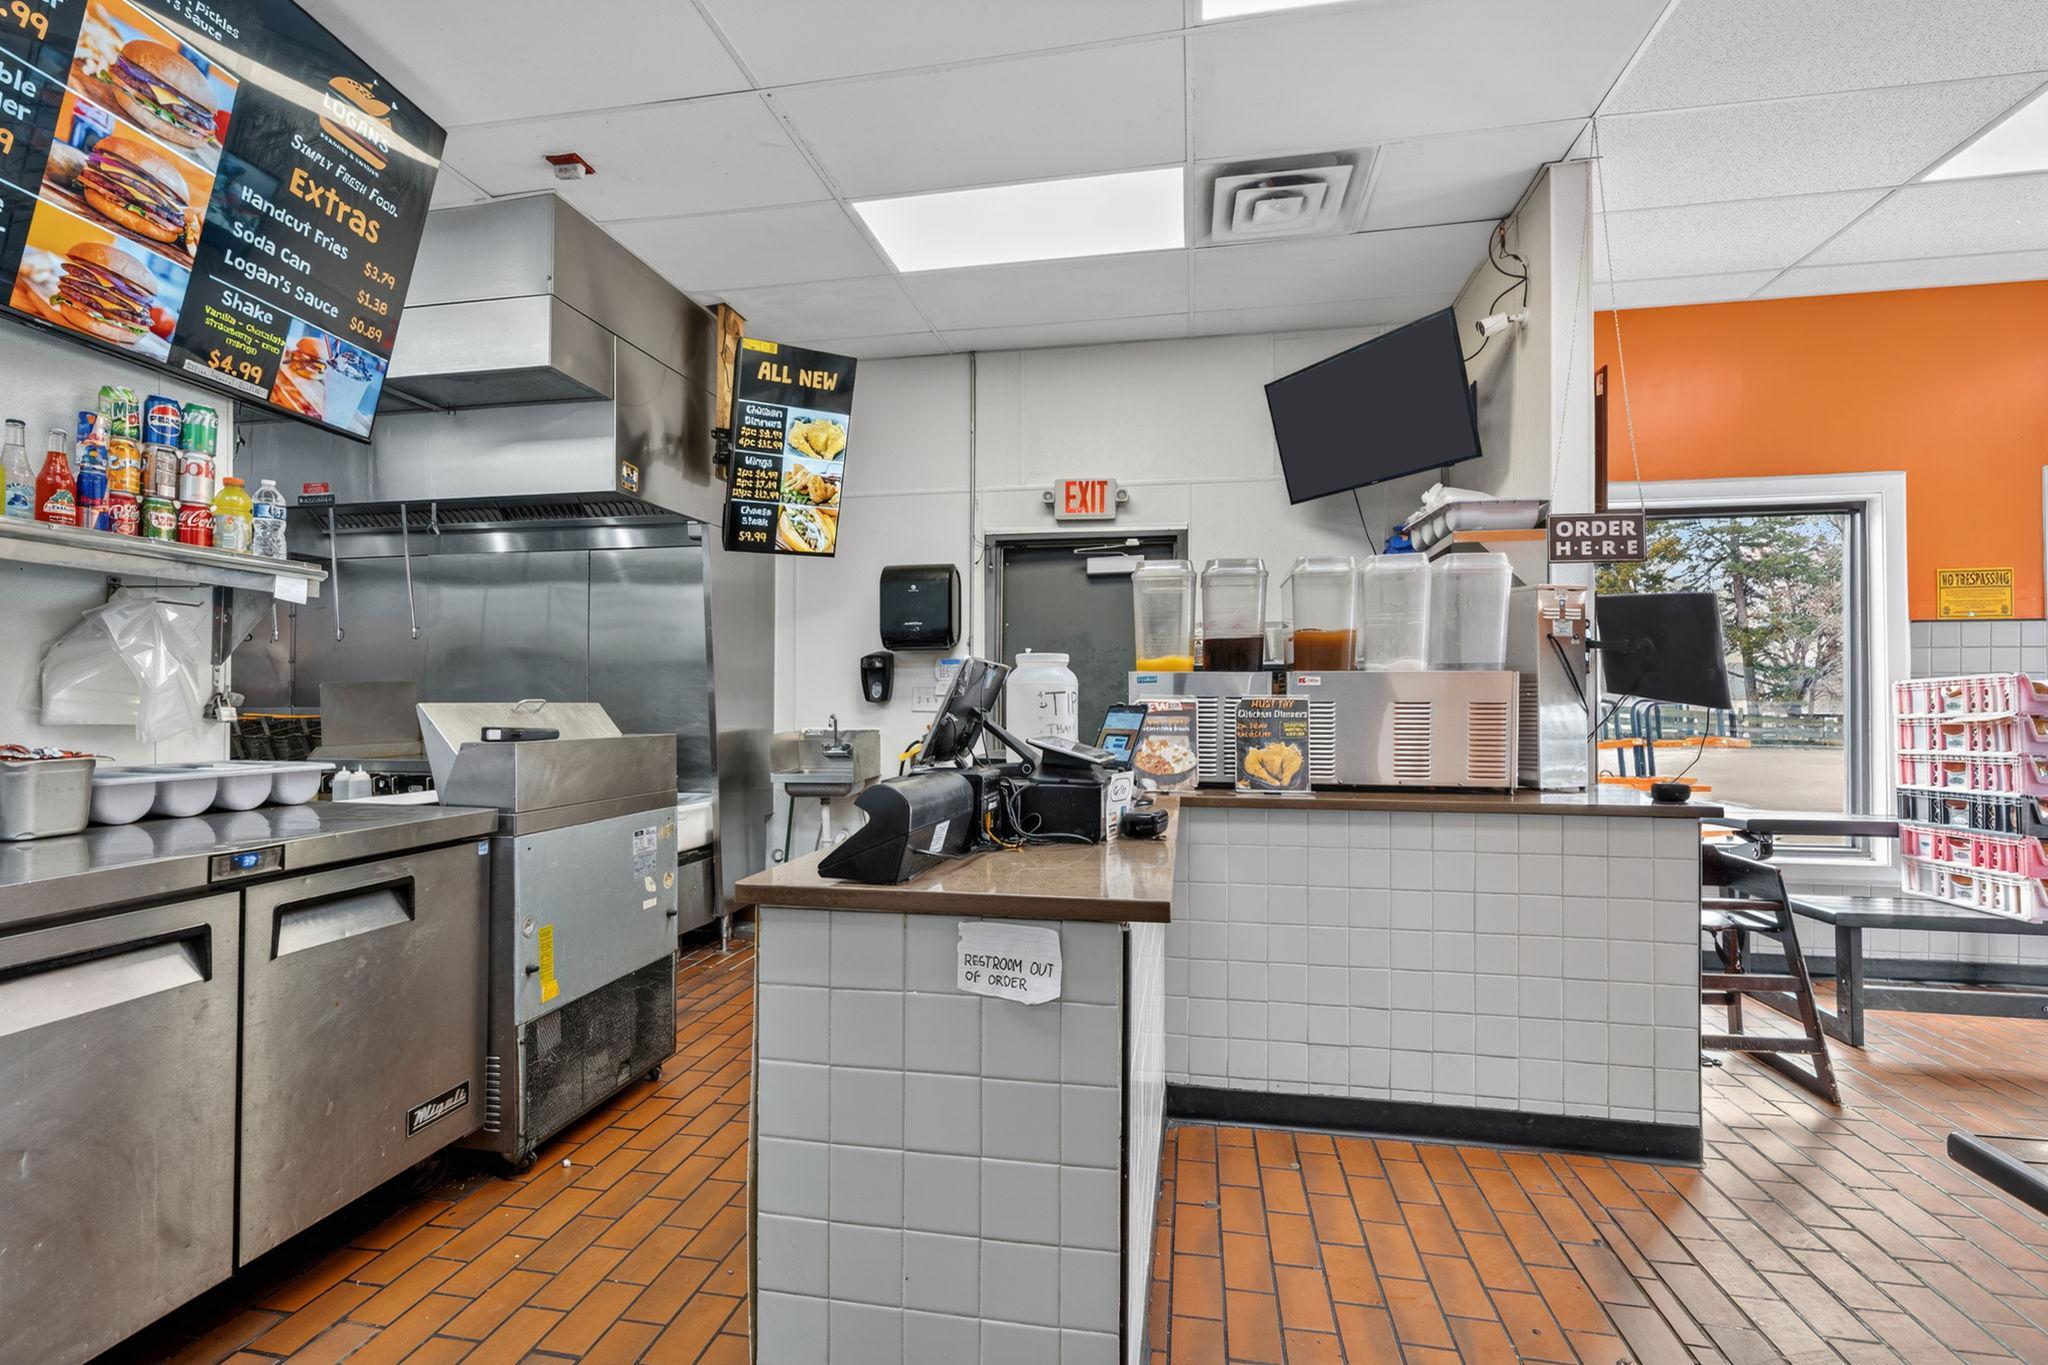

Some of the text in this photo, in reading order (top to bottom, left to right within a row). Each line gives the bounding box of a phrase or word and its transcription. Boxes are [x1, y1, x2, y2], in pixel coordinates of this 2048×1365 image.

[184, 7, 223, 41] Sauce
[289, 167, 381, 244] Extras
[241, 186, 349, 260] Handcut Fries
[232, 221, 312, 275] Soda Can
[224, 249, 339, 318] Logan's Sauce
[363, 261, 396, 290] $3.79
[221, 290, 274, 325] Shake
[357, 289, 389, 316] $1.38
[207, 348, 263, 385] $4.99
[757, 361, 838, 391] ALL NEW
[1065, 480, 1108, 513] EXIT
[738, 530, 767, 543] $9.99
[1556, 520, 1637, 537] ORDER
[1941, 571, 2010, 586] NO TRESPASSING
[964, 953, 1054, 978] RESTROOM OUT
[965, 970, 1027, 991] OF ORDER
